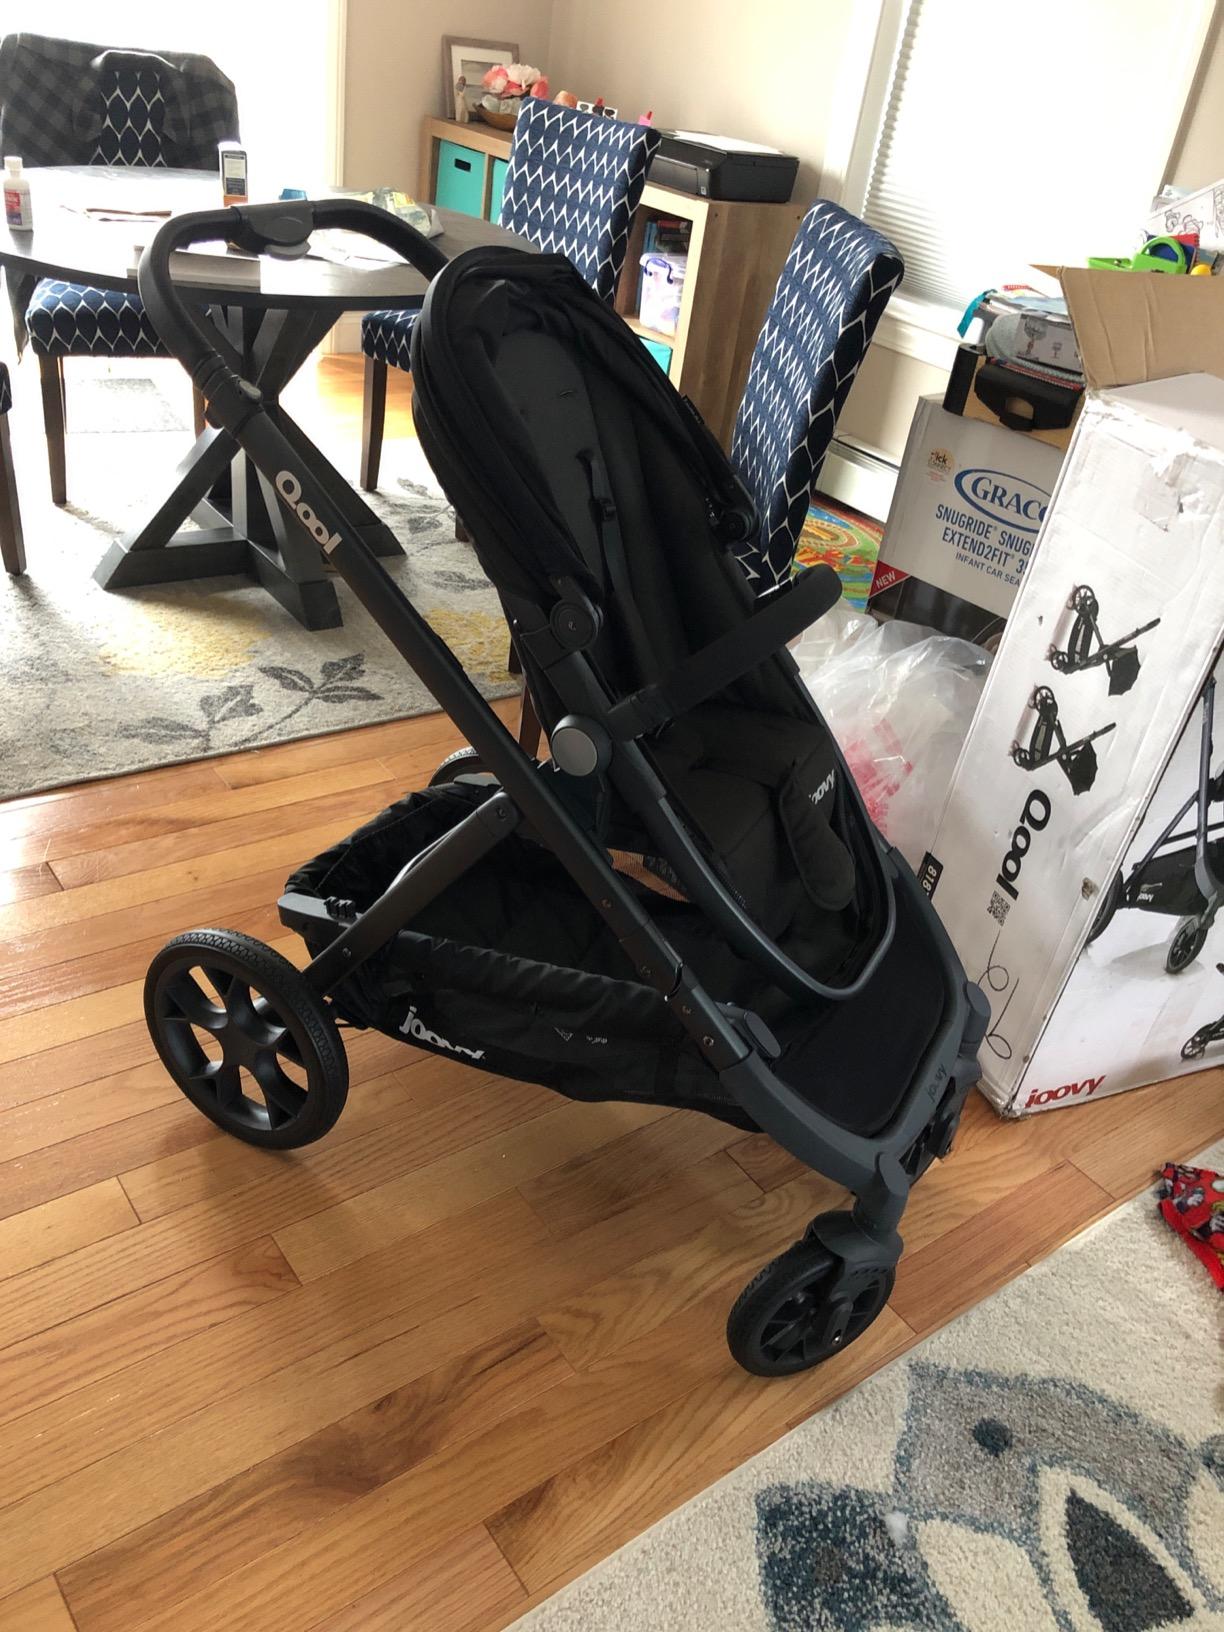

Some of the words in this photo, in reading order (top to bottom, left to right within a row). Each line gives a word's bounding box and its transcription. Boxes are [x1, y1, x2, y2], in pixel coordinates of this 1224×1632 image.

[275, 470, 342, 554] Qool
[935, 504, 994, 539] SNUGRIDE
[942, 527, 1010, 567] EXTEND2FIT
[875, 570, 896, 589] NEW
[955, 552, 985, 571] INFANT
[986, 565, 1003, 579] CAR
[808, 769, 835, 805] oovy
[995, 789, 1052, 900] Qool
[922, 865, 937, 896] 818
[927, 1063, 947, 1104] jovy
[1025, 1075, 1106, 1109] joovy
